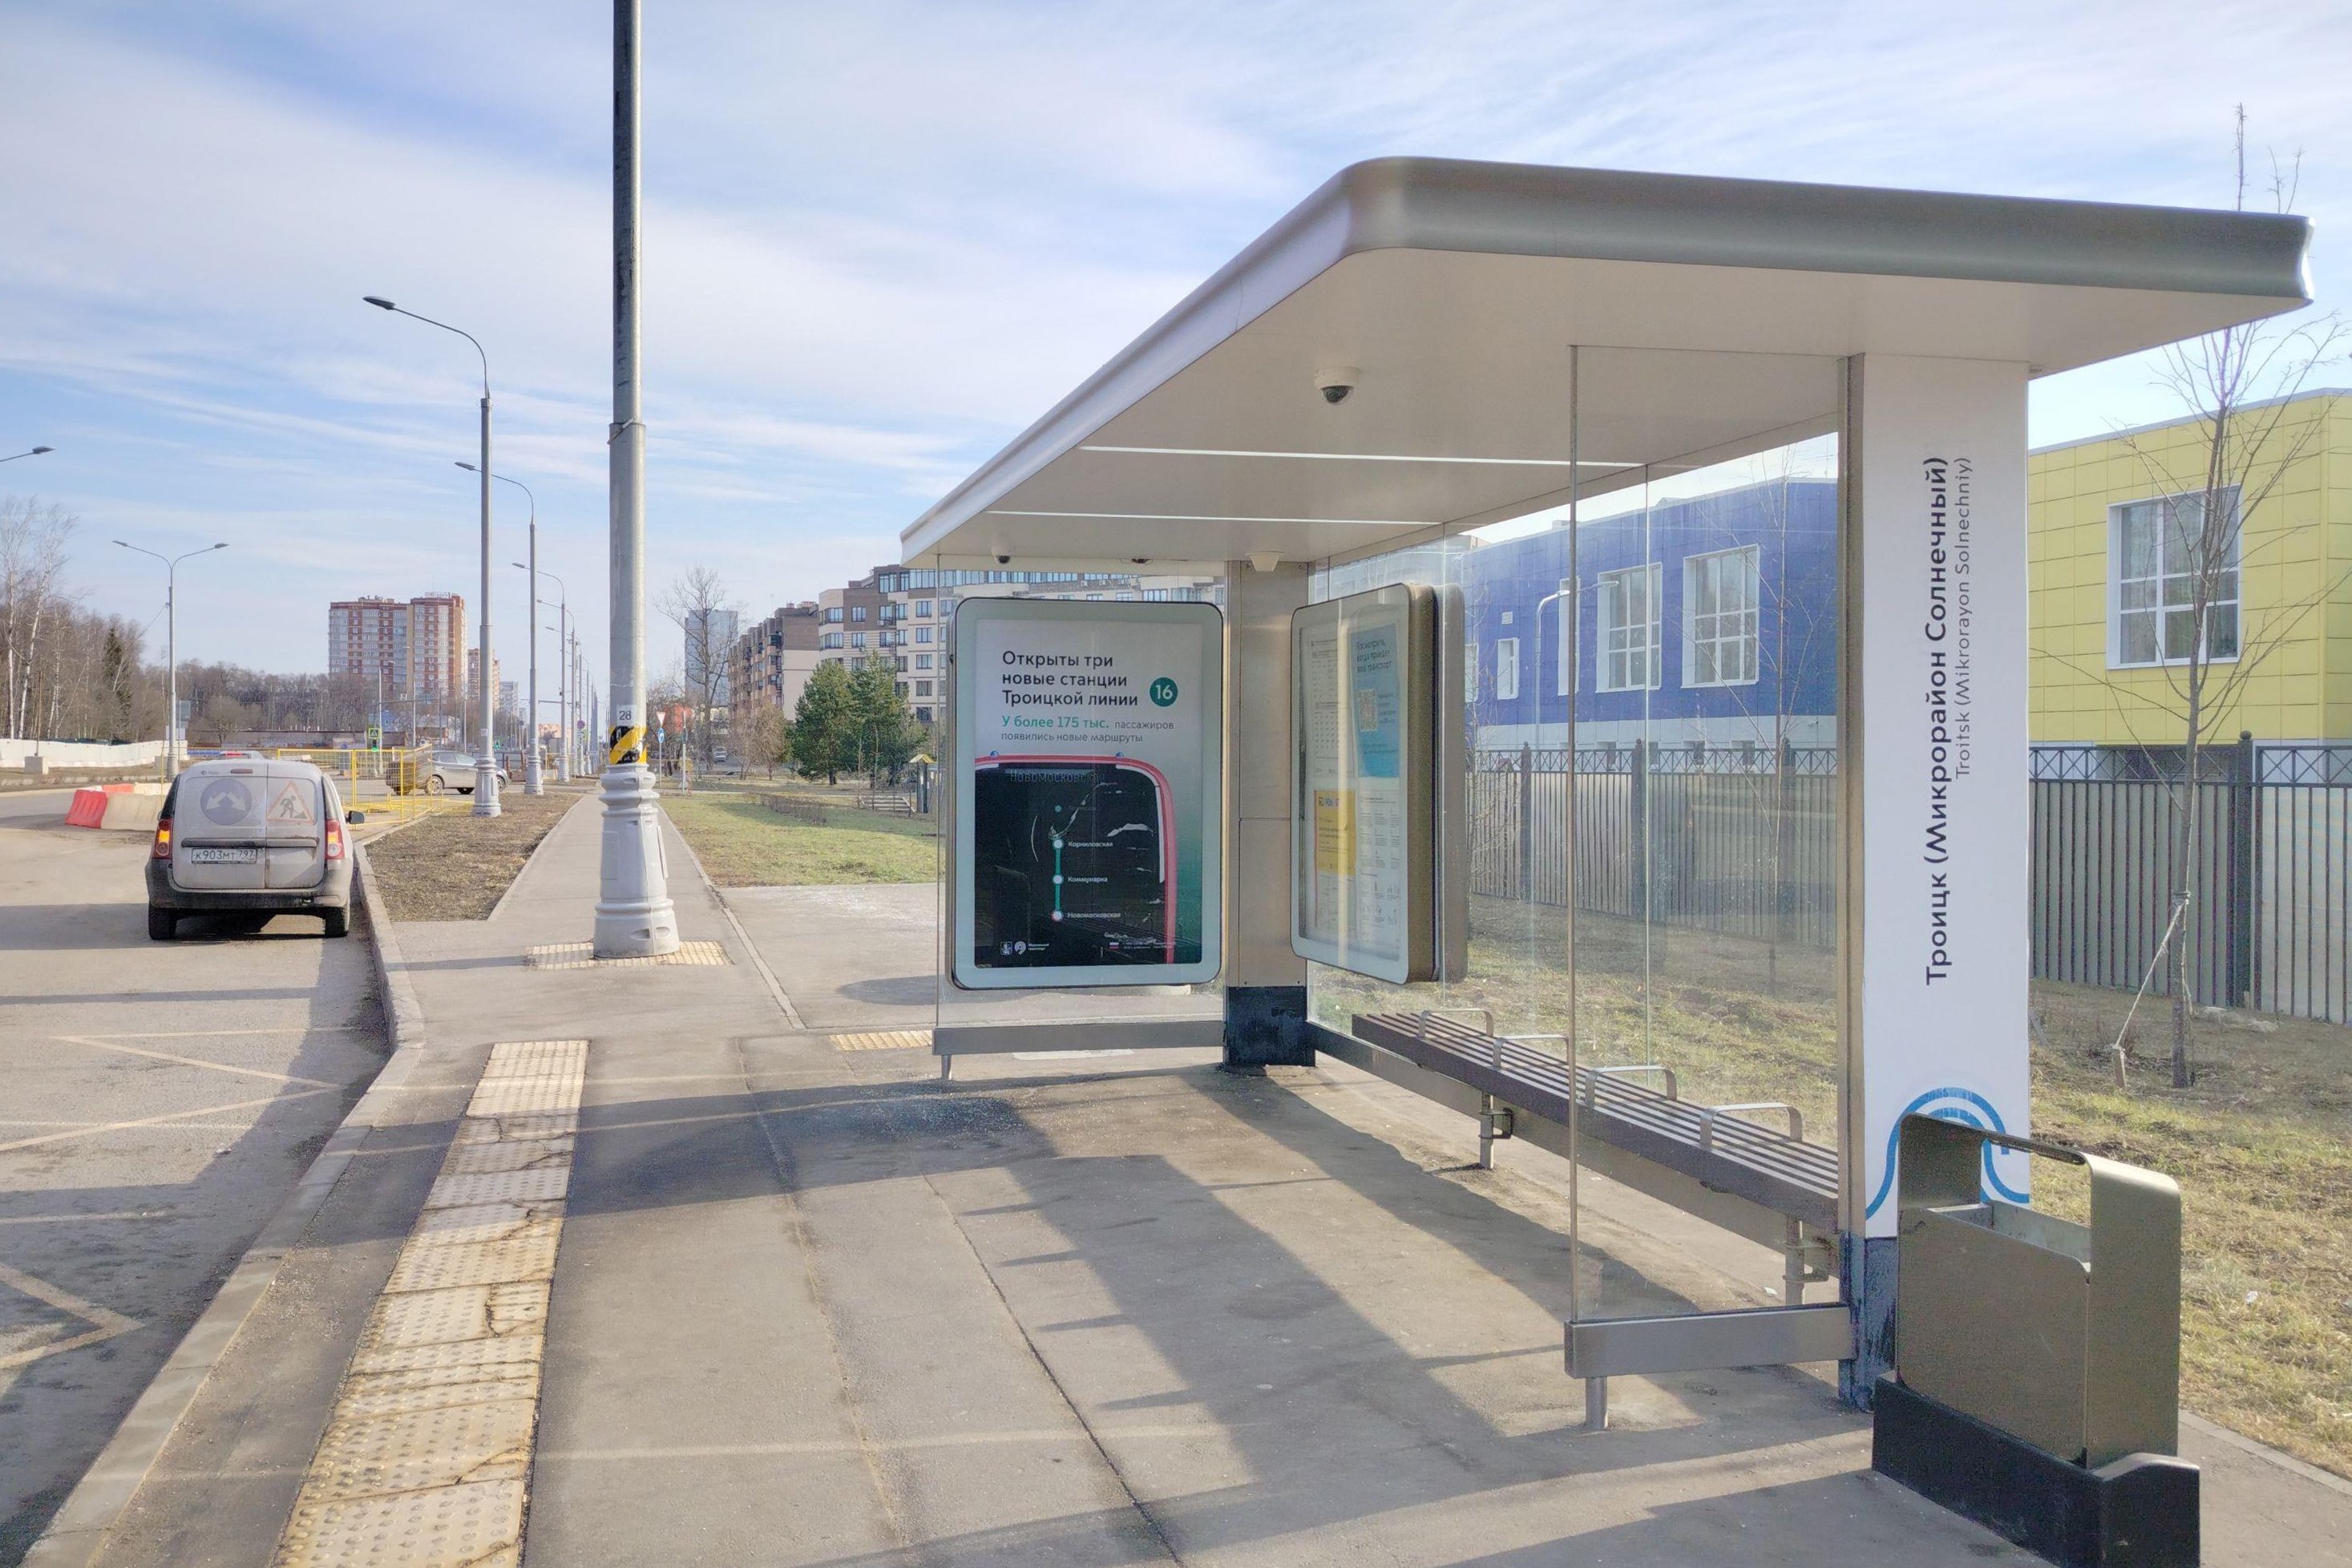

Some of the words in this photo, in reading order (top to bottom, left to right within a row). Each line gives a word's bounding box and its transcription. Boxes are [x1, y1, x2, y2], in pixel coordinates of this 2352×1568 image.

[1954, 457, 1973, 575] Solnechniy)
[1922, 457, 1949, 641] Солнечный)
[1954, 581, 1973, 705] (Mikrorayon
[1002, 650, 1079, 668] Открыты
[1083, 655, 1113, 670] три
[1002, 673, 1055, 686] новые
[1060, 675, 1127, 688] станции
[1002, 689, 1083, 707] Троицкой
[1088, 693, 1138, 706] линии
[1155, 685, 1173, 700] 16
[619, 710, 632, 721] 28
[1001, 716, 1010, 728] У
[1013, 715, 1053, 728] более
[1057, 717, 1079, 728] 175
[1083, 719, 1109, 729] тыс.
[1114, 721, 1174, 731] пассажиров
[1001, 732, 1054, 742] появились
[1057, 733, 1088, 742] новые
[1091, 734, 1142, 743] маршруты
[1954, 710, 1970, 779] Troitsk
[1923, 652, 1952, 863] (Микрорайон
[238, 849, 254, 859] 797
[1925, 872, 1952, 986] Троицк
